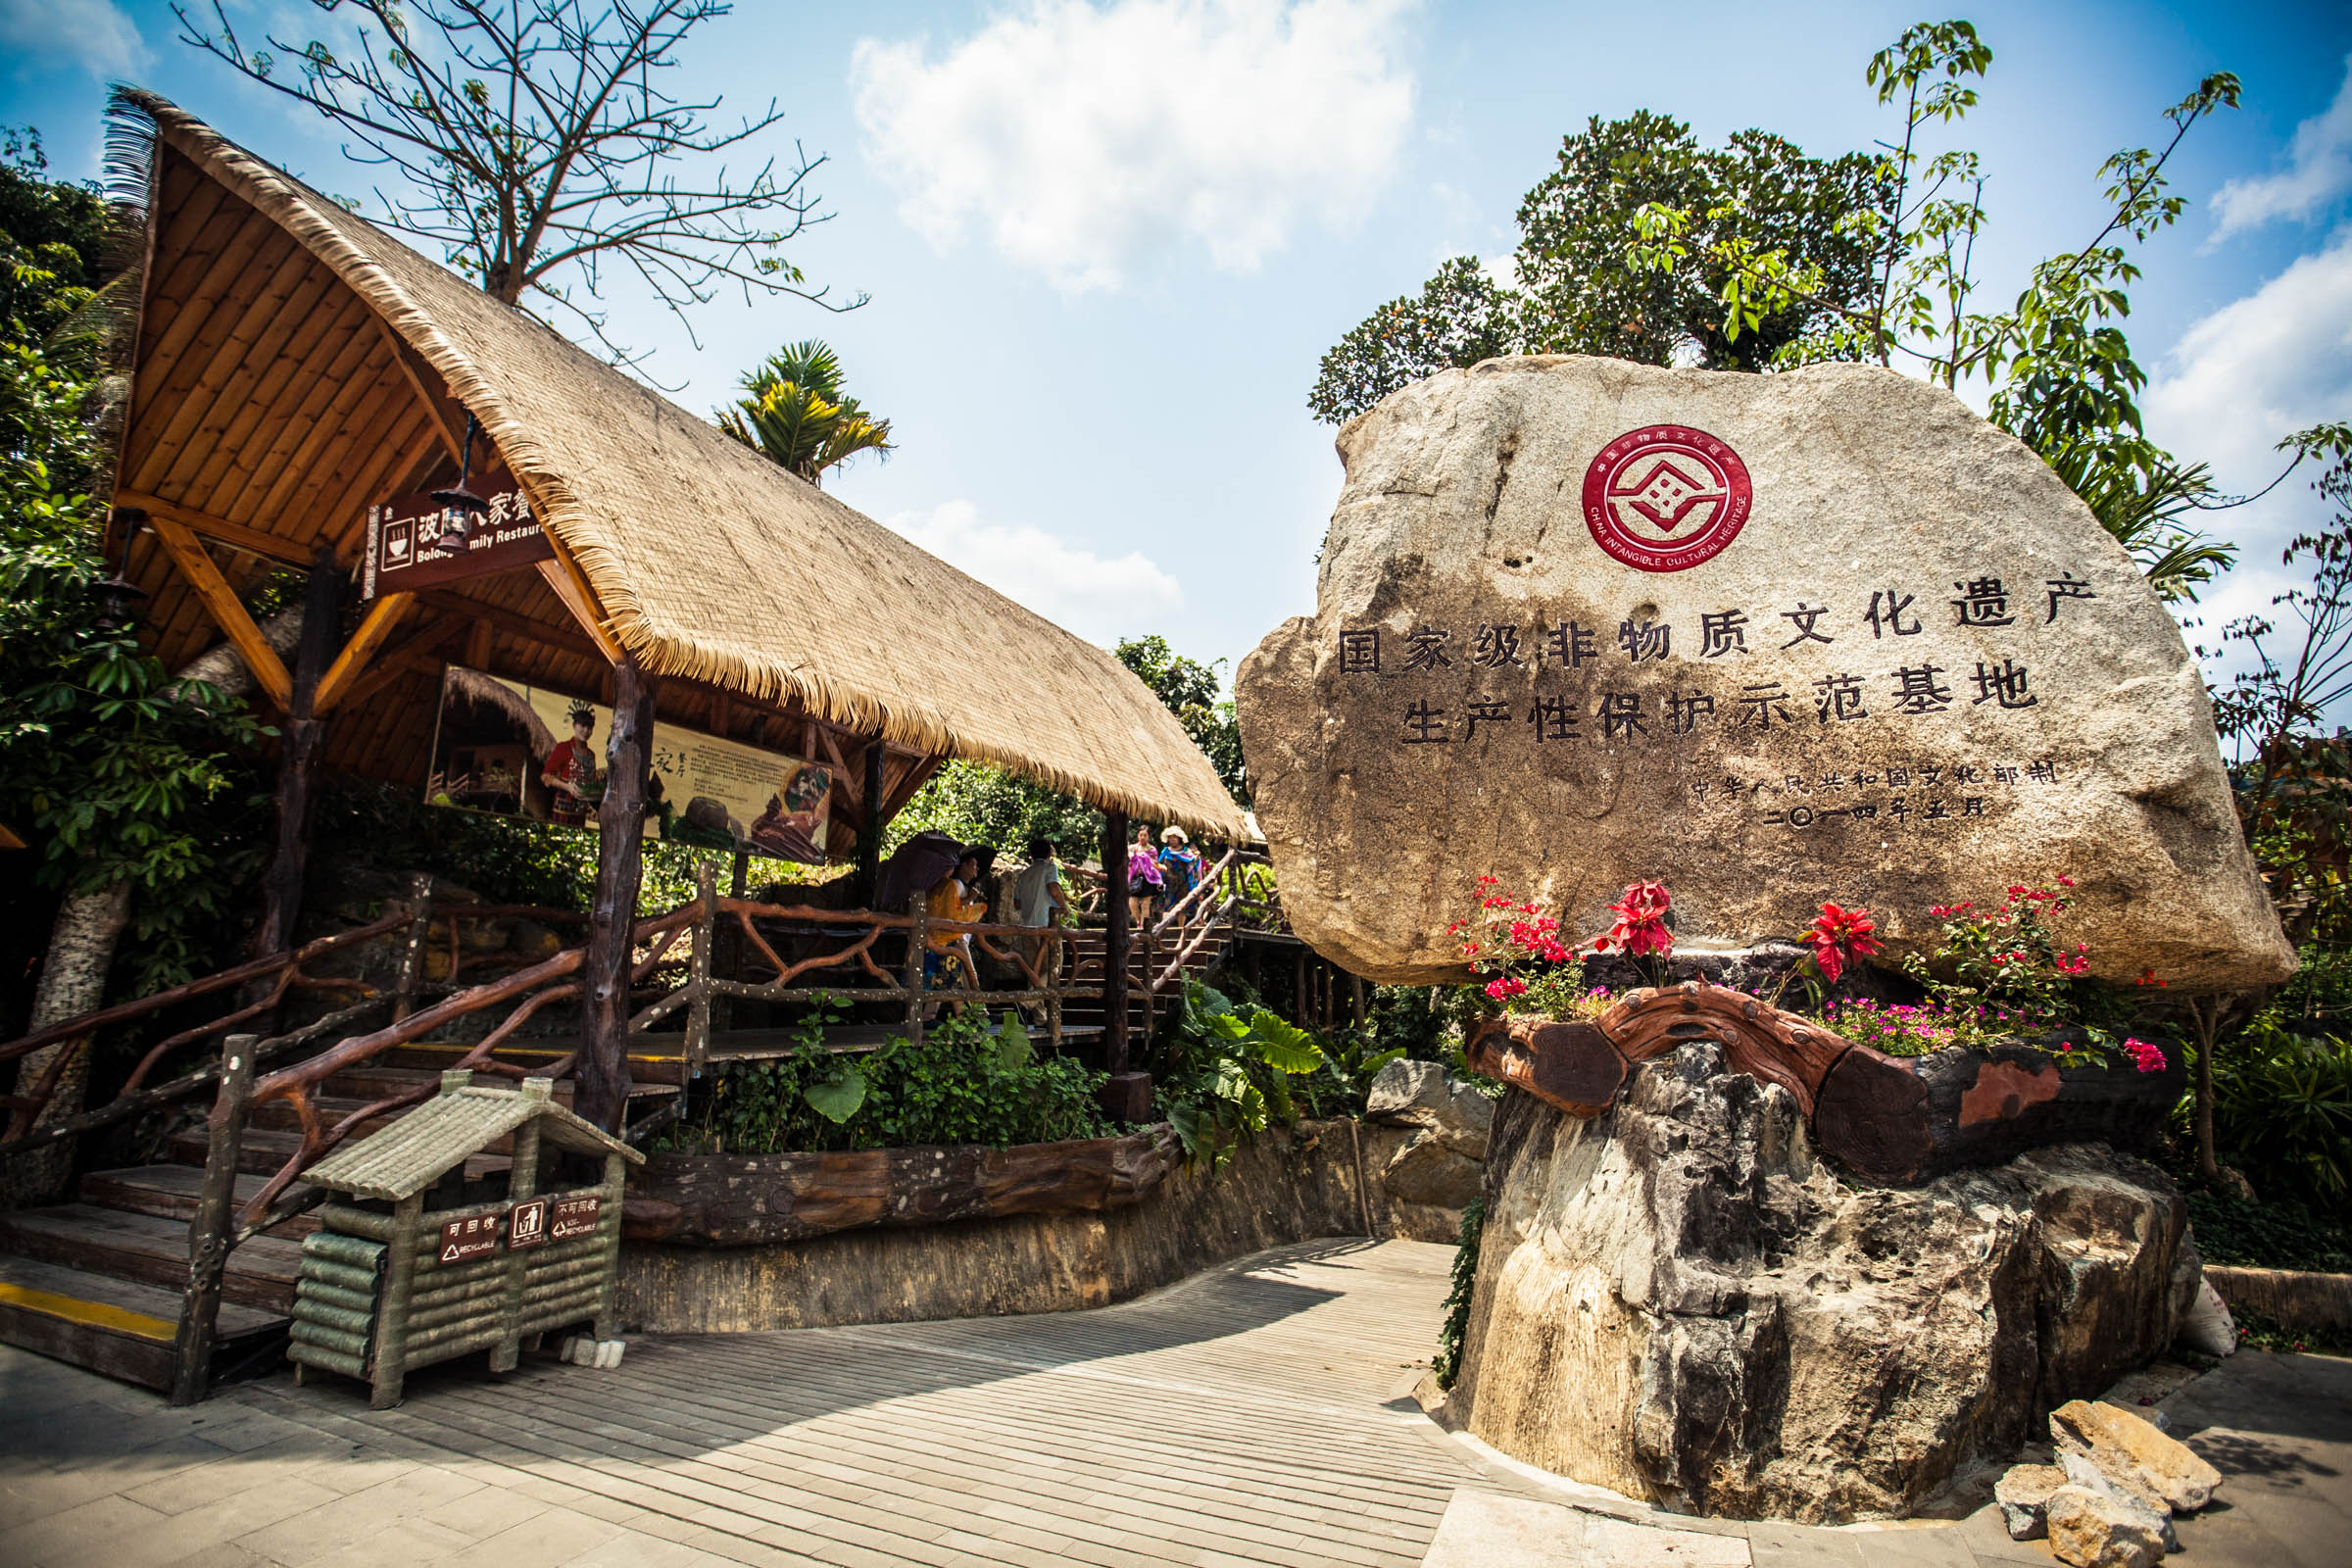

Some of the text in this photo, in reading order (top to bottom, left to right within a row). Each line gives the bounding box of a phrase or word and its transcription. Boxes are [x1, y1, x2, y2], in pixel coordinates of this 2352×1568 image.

[1591, 495, 1746, 566] CHINA INTANGIBLE CULTURAL HERITAGE
[1340, 571, 2097, 675] 国家级非物质文化遗产
[1402, 659, 2039, 745] 生产性保护示范基地
[1691, 760, 2057, 802] 中华人民共和国文化部制
[558, 1199, 597, 1216] 不可回收
[449, 1215, 496, 1236] 可回收
[565, 1223, 597, 1235] RECYCLABLE
[459, 1240, 495, 1254] RECYCLABLE
